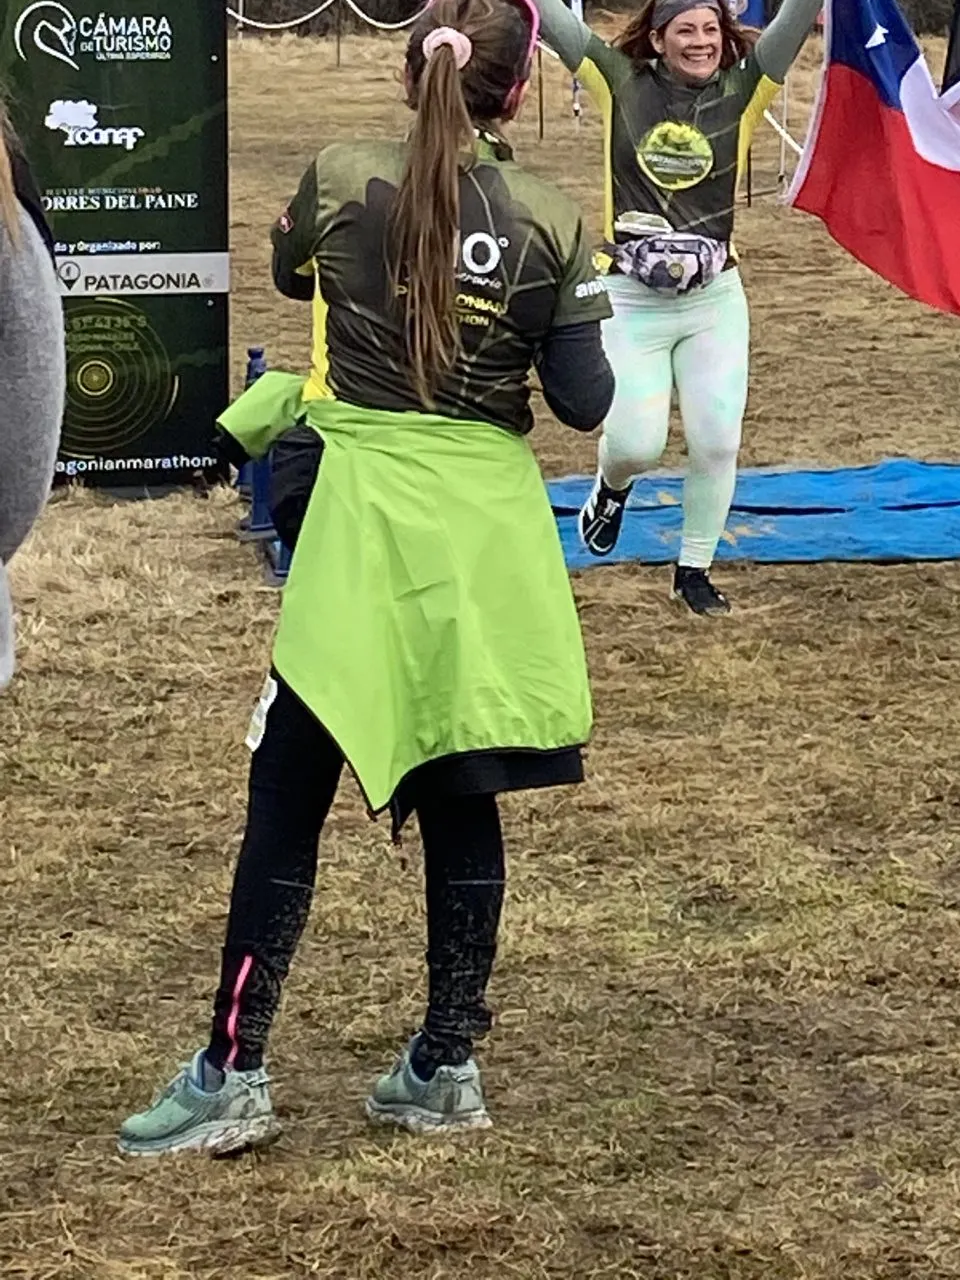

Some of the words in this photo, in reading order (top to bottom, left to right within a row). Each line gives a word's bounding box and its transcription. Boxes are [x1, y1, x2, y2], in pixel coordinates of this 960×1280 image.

[80, 12, 172, 37] CÁMARA
[93, 34, 172, 52] TURISMO
[40, 194, 101, 211] ORRES
[104, 194, 142, 210] DEL
[145, 192, 199, 209] PAINE
[84, 272, 201, 291] PATAGONIA
